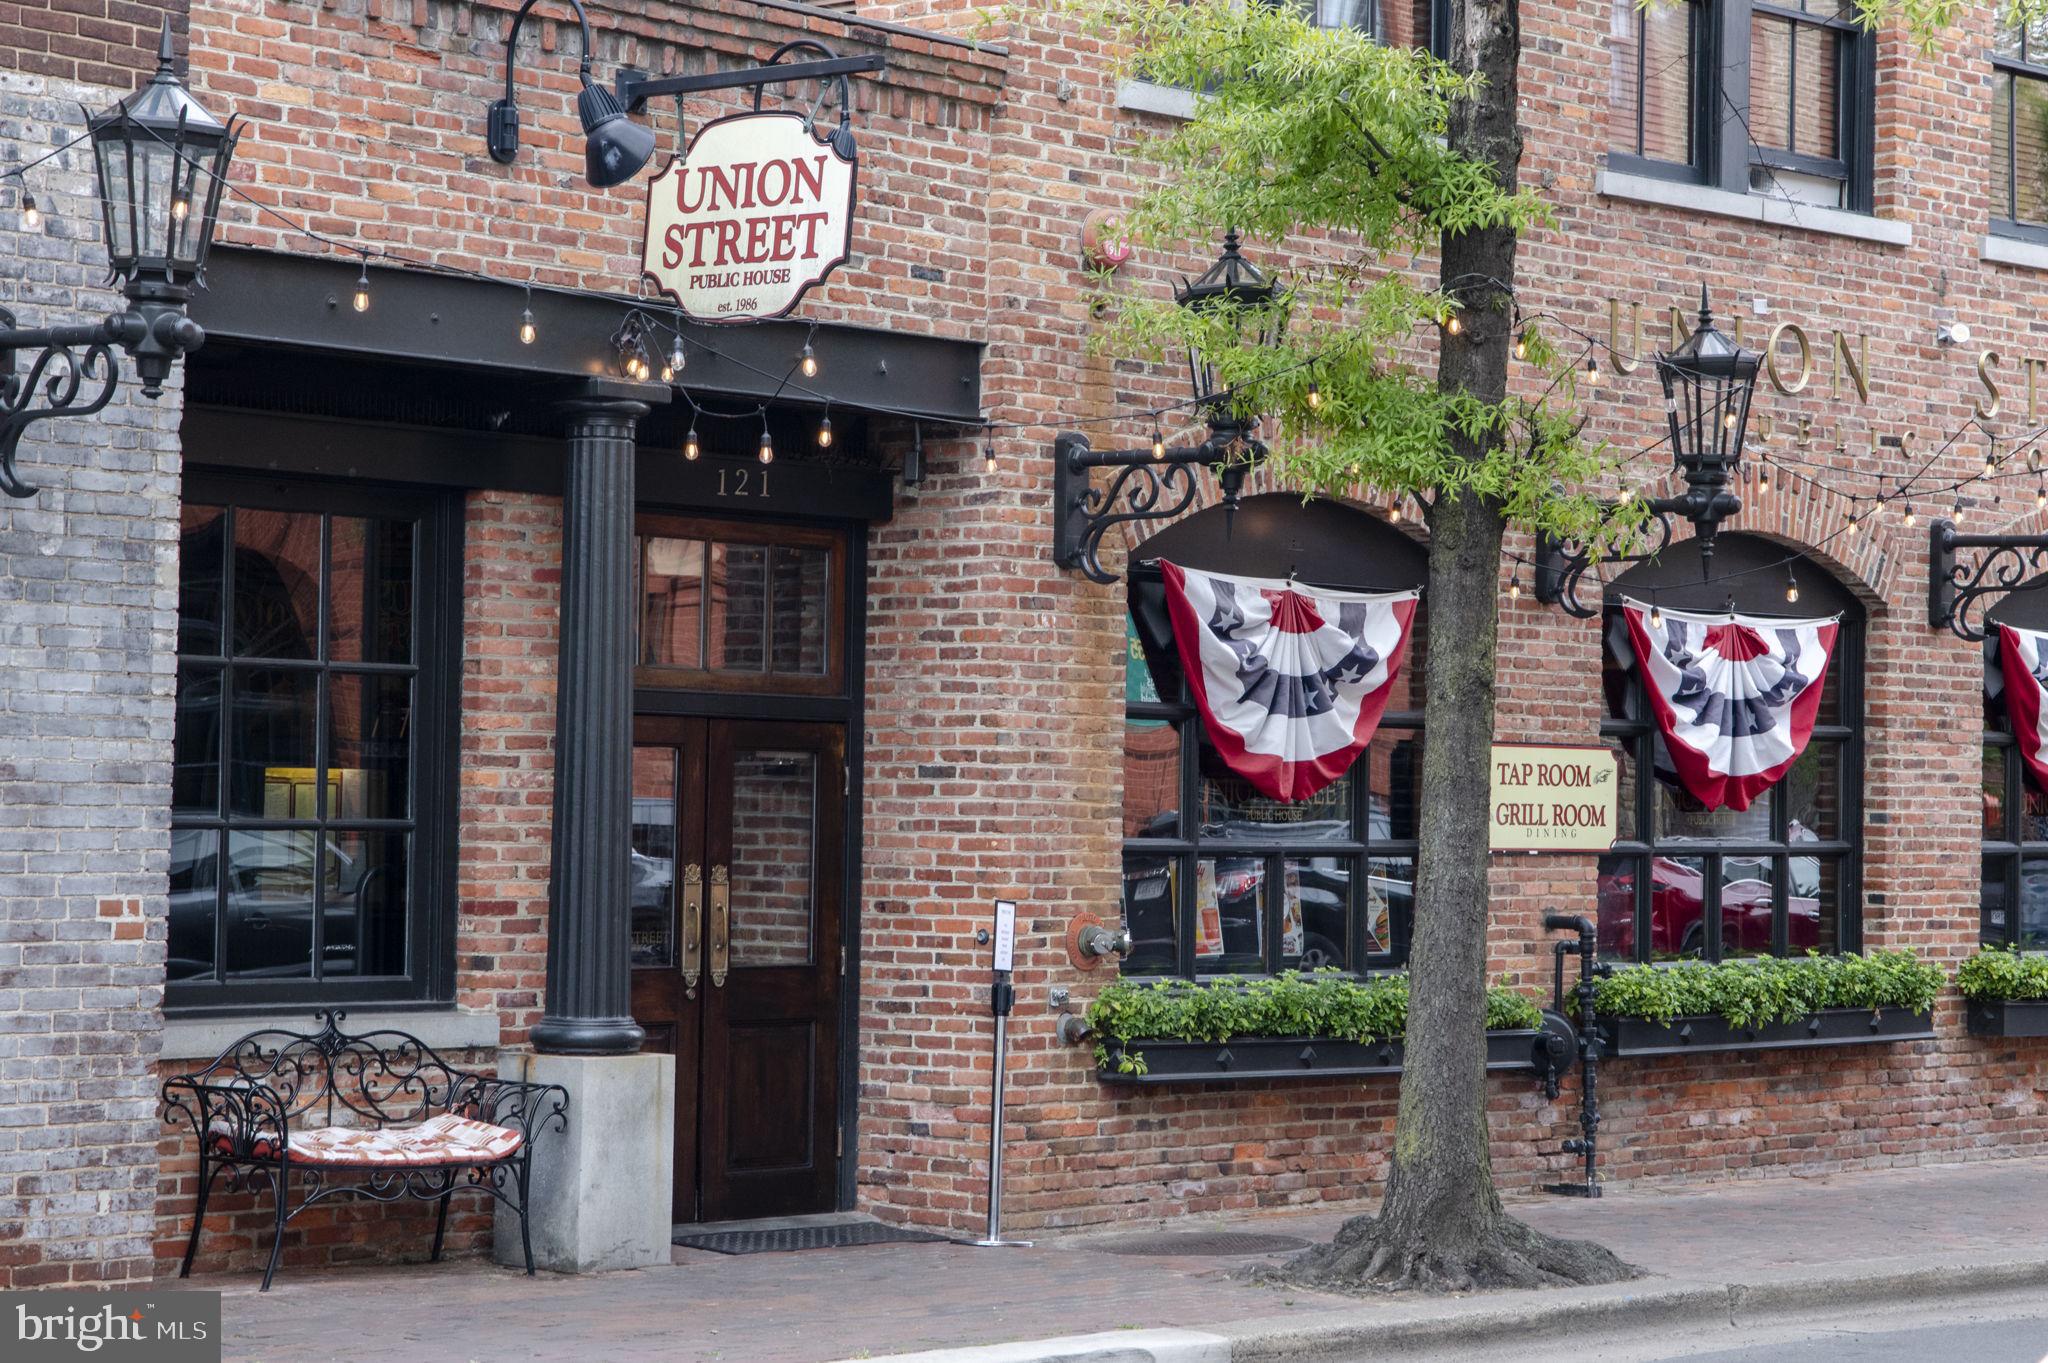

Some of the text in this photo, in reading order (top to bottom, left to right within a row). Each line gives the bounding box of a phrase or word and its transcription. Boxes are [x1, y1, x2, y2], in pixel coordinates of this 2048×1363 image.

[675, 155, 828, 214] UNION
[662, 211, 829, 270] STREET
[689, 268, 791, 290] PUBLIC HOUSE
[717, 297, 758, 313] est. 1986
[1719, 411, 1916, 459] UBLIC
[716, 468, 771, 498] 121
[1497, 762, 1592, 787] TAP ROOM
[1246, 809, 1303, 821] PUBLIC HOUSE
[1496, 802, 1607, 828] GRILL ROOM
[1526, 827, 1578, 839] DINING
